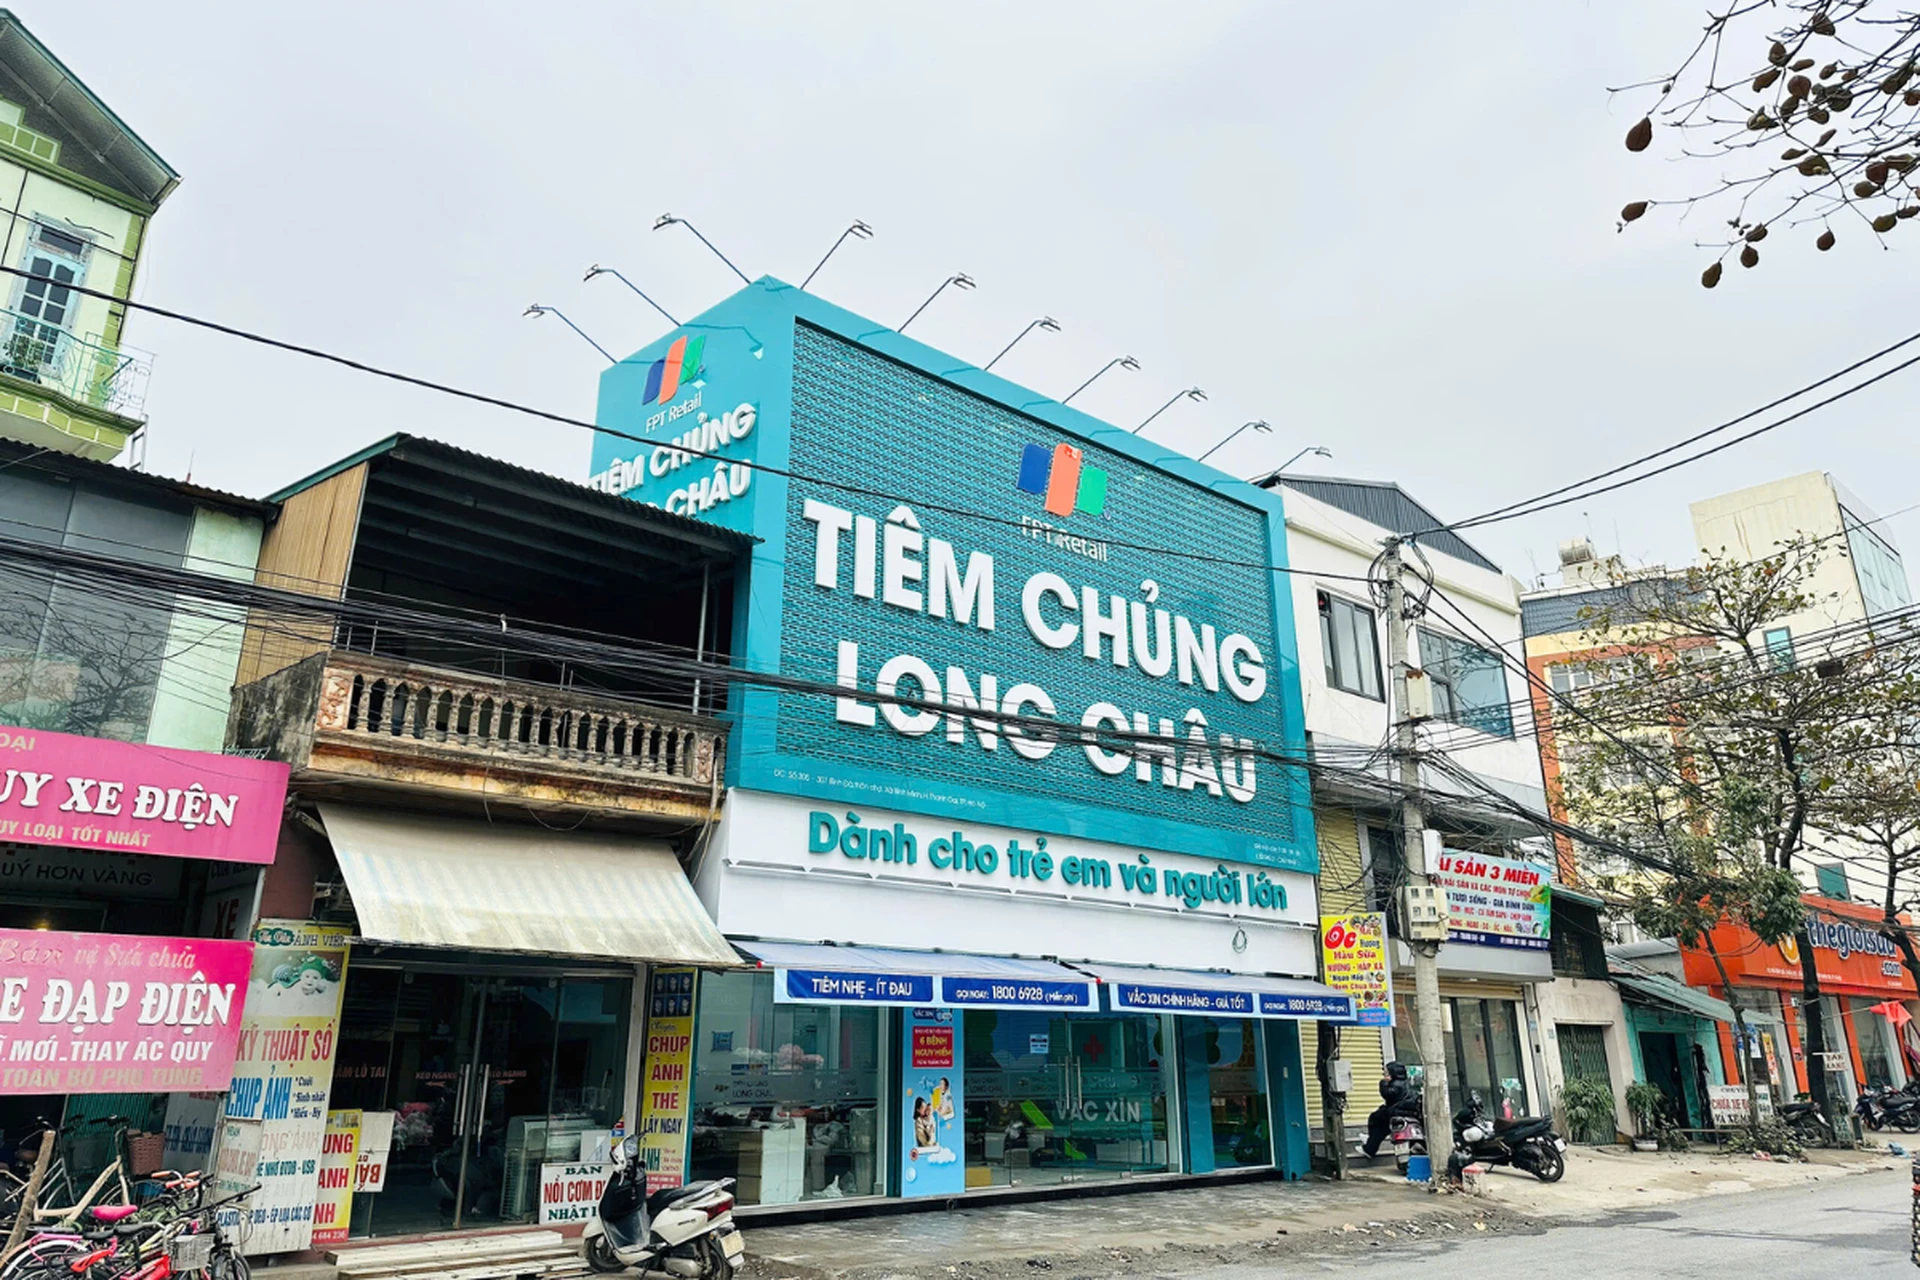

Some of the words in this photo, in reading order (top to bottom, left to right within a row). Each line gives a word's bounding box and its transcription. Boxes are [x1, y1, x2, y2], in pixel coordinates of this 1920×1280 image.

[646, 408, 667, 433] FPT
[668, 388, 702, 423] Retail
[589, 454, 645, 496] TIÊM
[649, 402, 756, 477] CHỦNG
[665, 459, 752, 517] CHÂU
[1021, 515, 1054, 544] FPT
[1056, 528, 1108, 562] Retail
[803, 498, 996, 631] TIÊM
[1021, 572, 1267, 702] CHỦNG
[836, 639, 1058, 760] LONG
[1081, 702, 1258, 802] CHÂU
[59, 777, 124, 816] XE
[132, 782, 239, 830] ĐIỆN
[23, 822, 63, 841] LOẠI
[72, 824, 103, 842] TỐT
[106, 828, 151, 847] NHẤT
[36, 864, 86, 882] HƠN
[92, 865, 153, 886] VÀNG
[809, 811, 917, 865] Dành
[929, 831, 999, 875] cho
[1007, 836, 1054, 880] trẻ
[1061, 855, 1111, 889] em
[1118, 854, 1157, 895] và
[1164, 864, 1242, 909] người
[1246, 872, 1288, 910] lớn
[1454, 856, 1487, 878] SẢN
[1490, 866, 1501, 880] 3
[1503, 864, 1540, 886] MIỀN
[38, 979, 130, 1034] ĐẠP
[137, 970, 236, 1036] ĐIỆN
[811, 975, 840, 994] TIÊM
[841, 980, 866, 998] NHẸ
[876, 977, 887, 995] ÍT
[888, 982, 912, 996] ĐAU
[991, 985, 1016, 999] 1800
[1017, 986, 1043, 1001] 6928
[261, 1022, 310, 1068] THUẬT
[311, 1018, 336, 1061] SỐ
[650, 1036, 690, 1057] CHỤP
[651, 1057, 683, 1081] ẢNH
[652, 1084, 679, 1110] THẺ
[567, 1180, 593, 1202] CƠM
